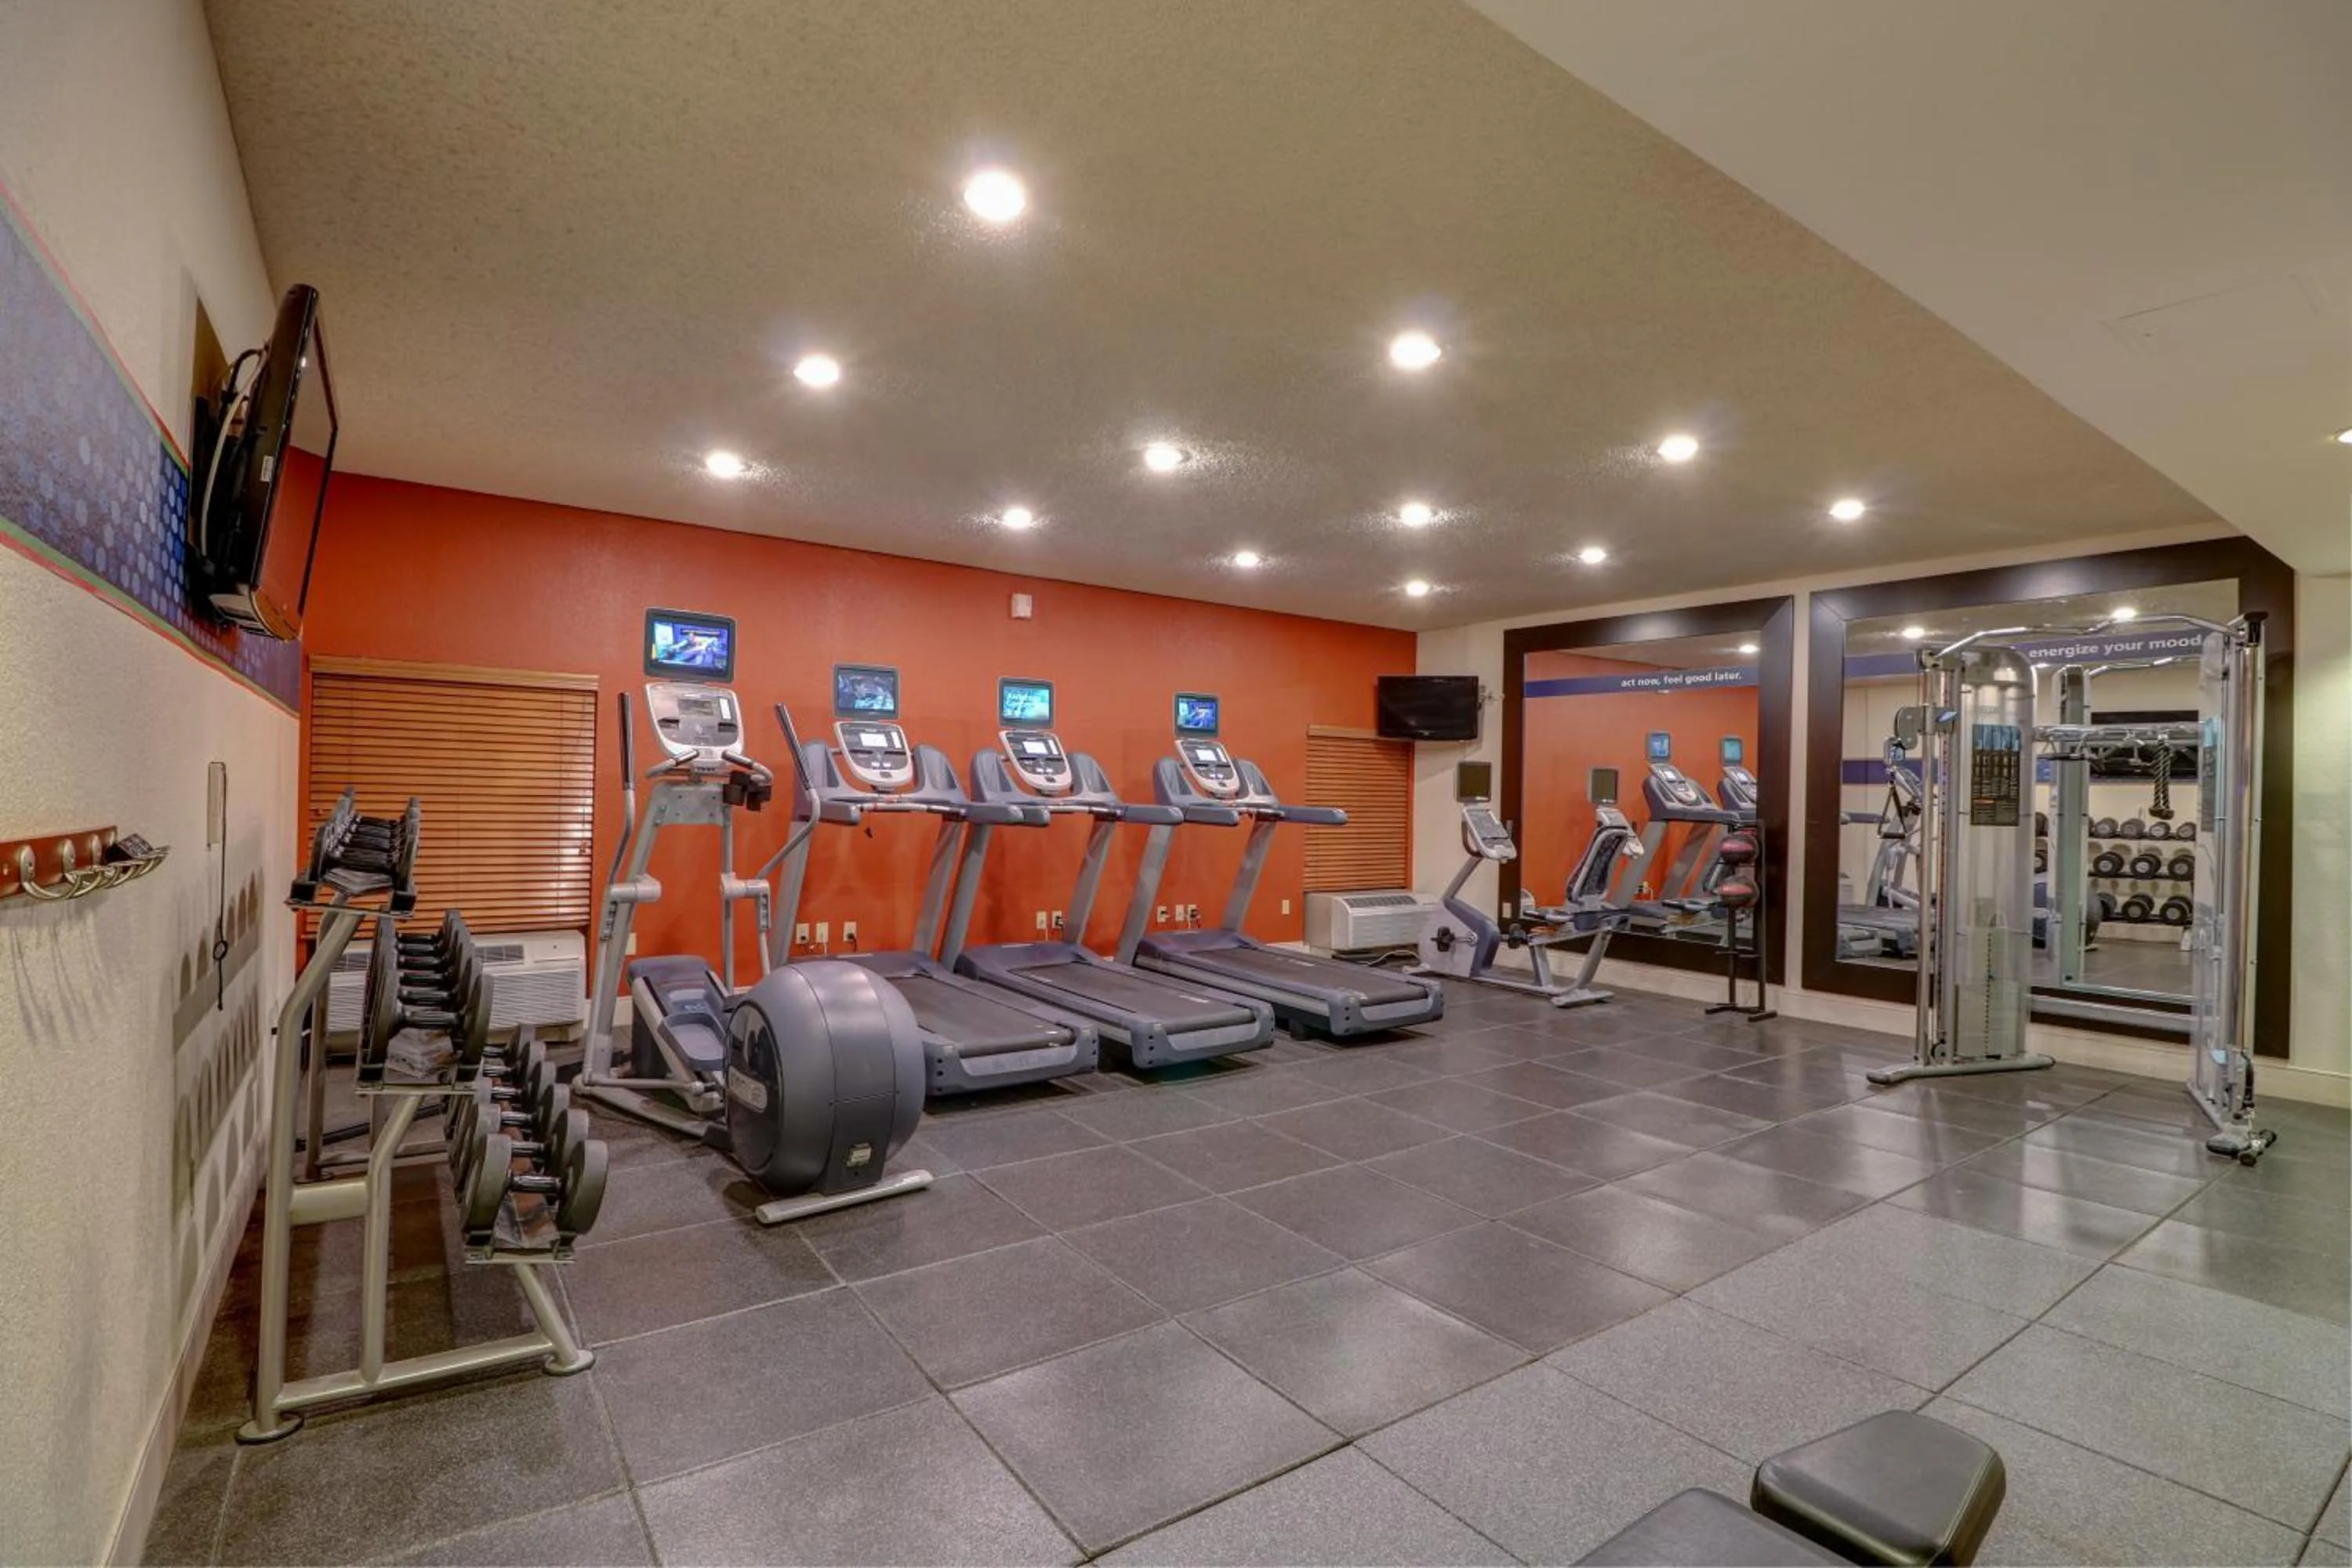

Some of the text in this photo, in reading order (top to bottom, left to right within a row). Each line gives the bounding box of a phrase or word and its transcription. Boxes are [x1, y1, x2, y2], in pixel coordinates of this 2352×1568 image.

[2028, 634, 2202, 659] energize your mood
[1621, 671, 1743, 688] act now, feel good later.
